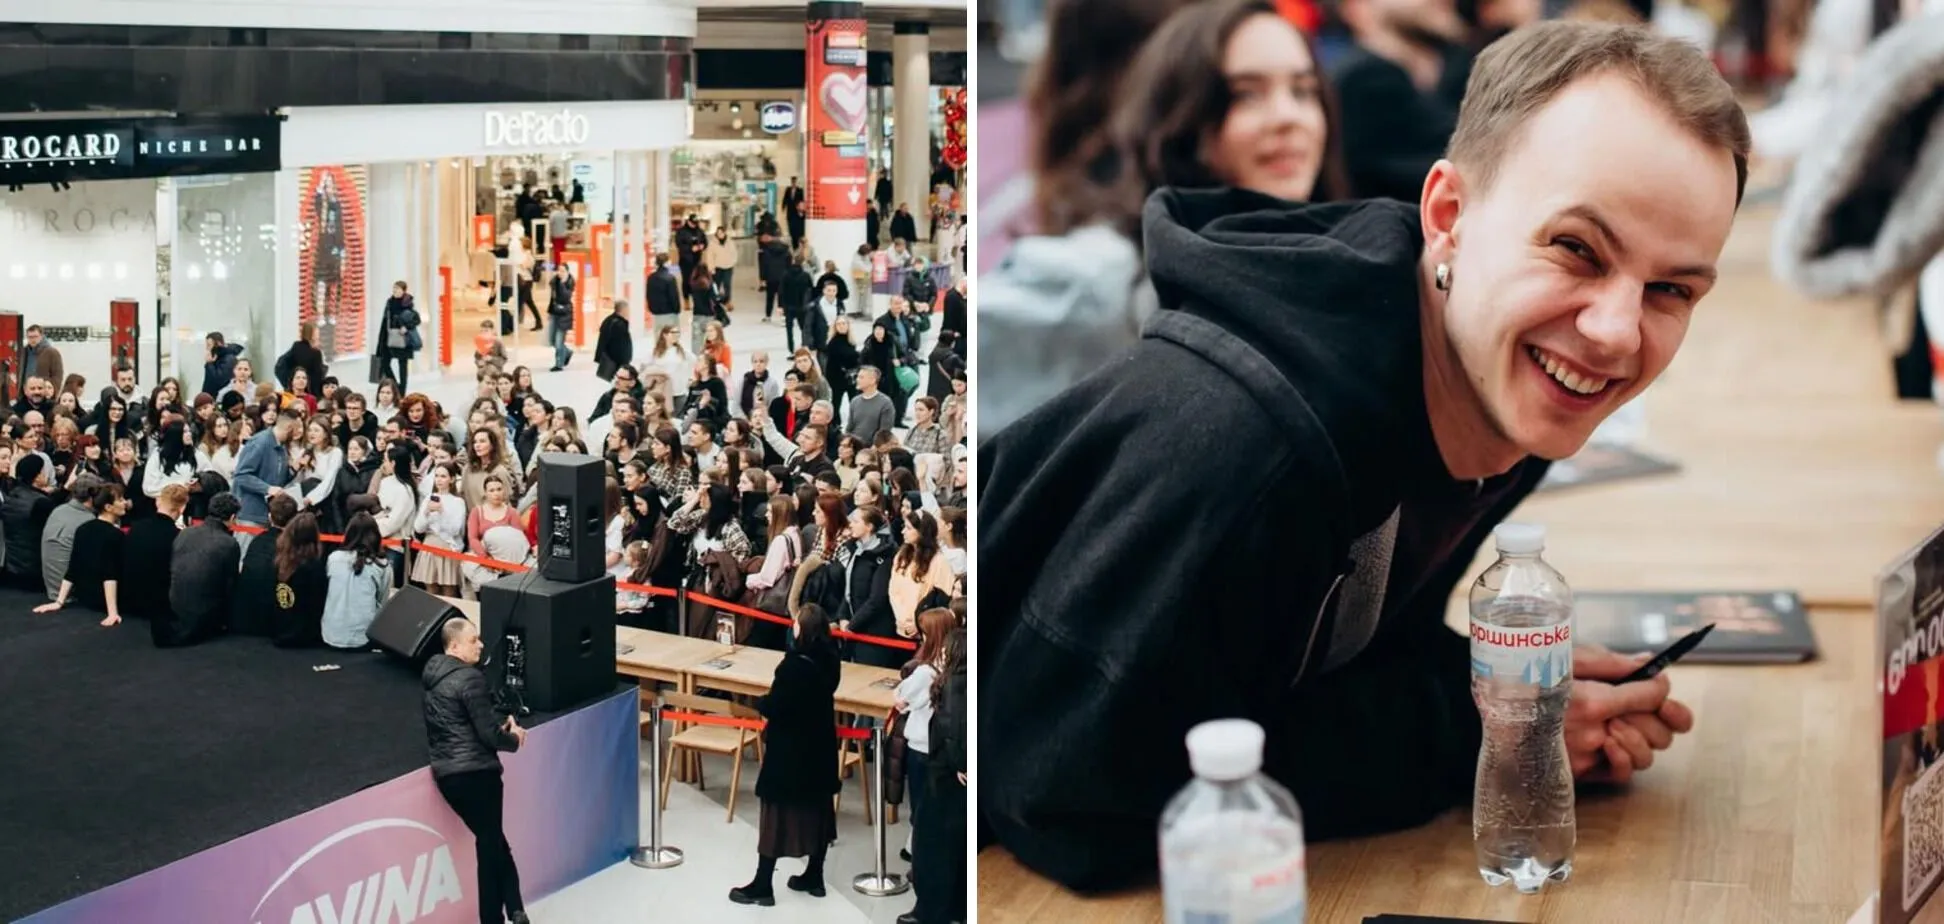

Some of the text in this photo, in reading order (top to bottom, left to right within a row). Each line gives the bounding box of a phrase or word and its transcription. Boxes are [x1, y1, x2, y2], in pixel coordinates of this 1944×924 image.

[139, 140, 208, 154] NICHE
[224, 138, 262, 152] BAR
[484, 107, 590, 147] DeFacto
[253, 844, 463, 924] VINA
